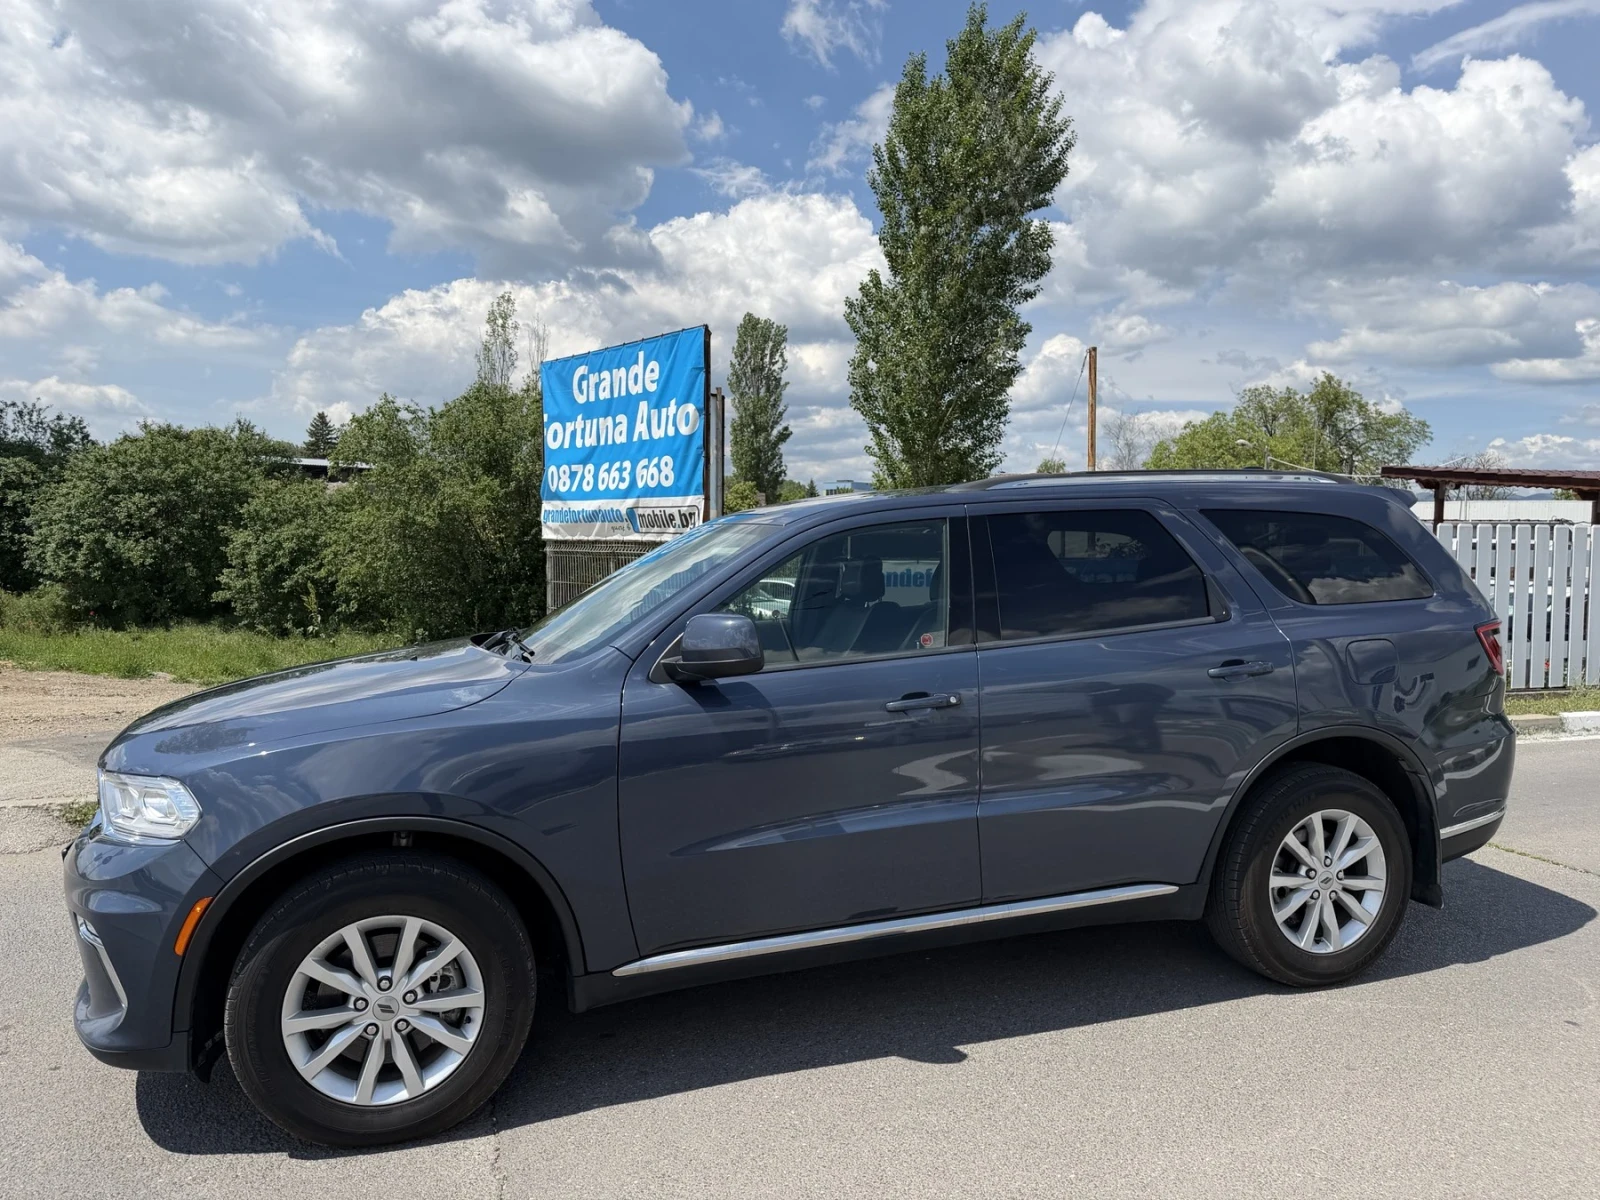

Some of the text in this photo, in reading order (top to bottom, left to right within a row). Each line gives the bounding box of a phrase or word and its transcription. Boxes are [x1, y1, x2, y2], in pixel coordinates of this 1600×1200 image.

[573, 351, 660, 404] Grande
[633, 398, 700, 442] Auto
[547, 455, 675, 493] 0878 663 668
[637, 509, 697, 530] mobile.bg
